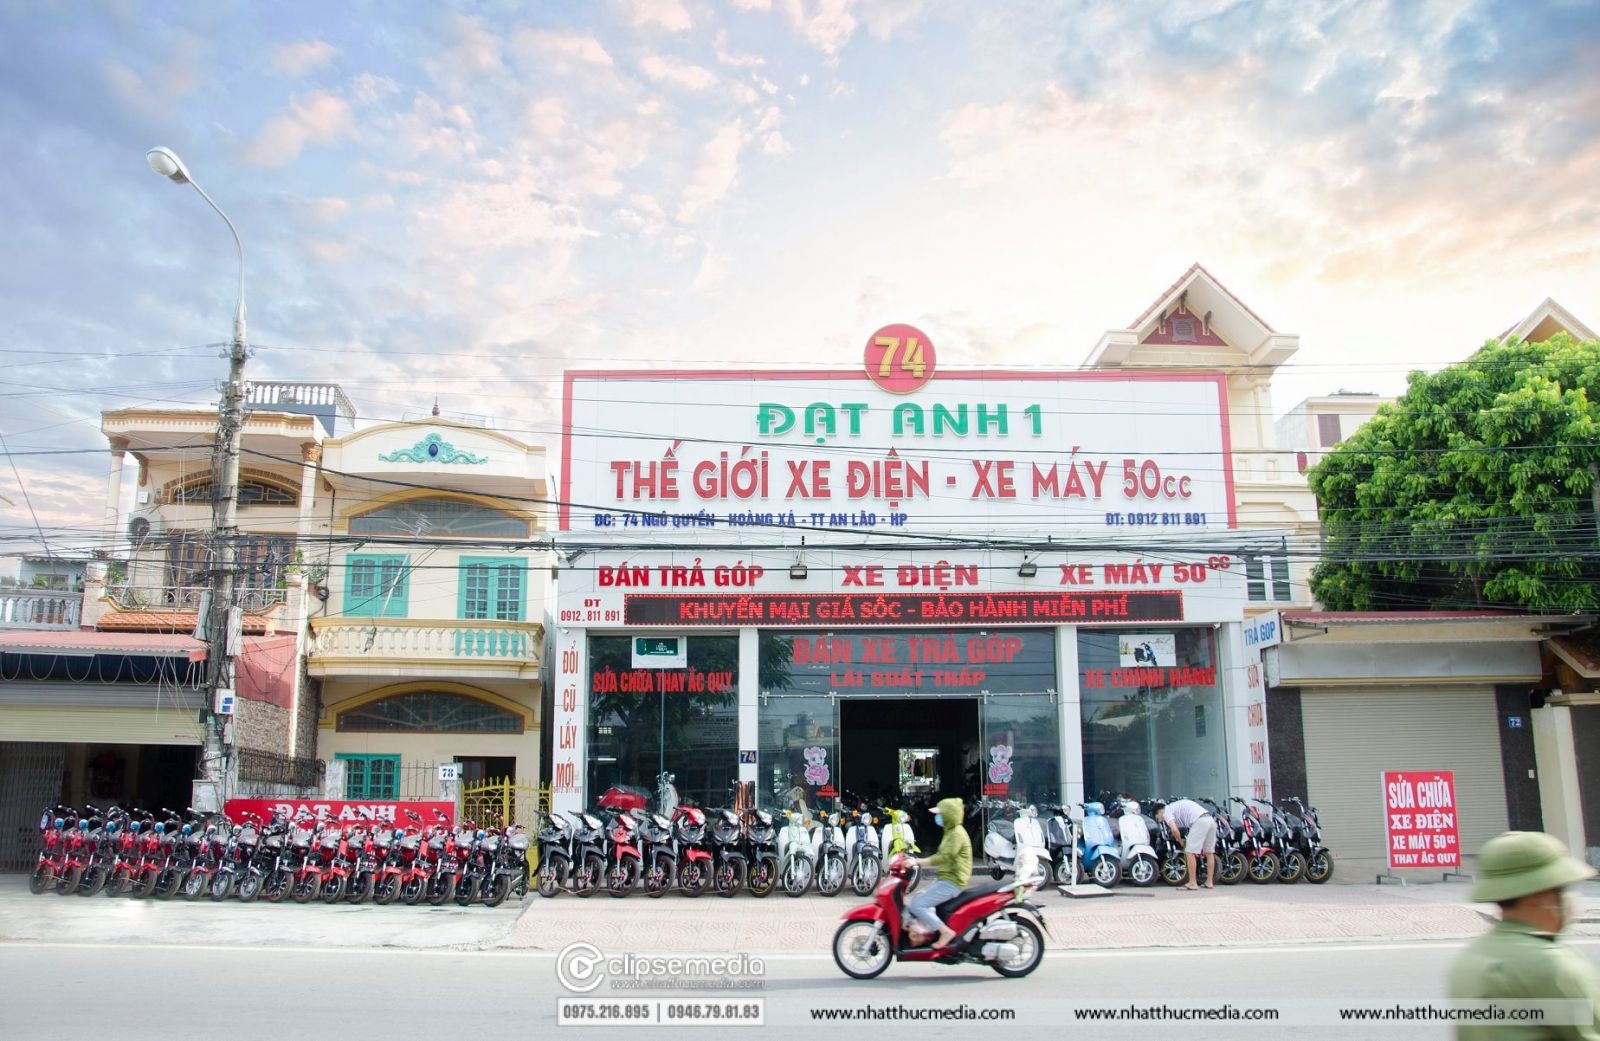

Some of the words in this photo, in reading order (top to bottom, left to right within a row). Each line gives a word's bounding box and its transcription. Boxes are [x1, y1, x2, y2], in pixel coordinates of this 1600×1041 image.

[875, 336, 926, 378] 74
[756, 402, 869, 444] ĐẠT
[892, 402, 1009, 437] ANH
[1024, 403, 1042, 437] 1
[610, 439, 681, 500] THẾ
[785, 460, 831, 499] XE
[846, 446, 930, 507] ĐIỆN
[972, 460, 1016, 499] XE
[1032, 446, 1108, 499] MÁY
[1123, 459, 1192, 499] 50cc
[594, 513, 616, 527] ĐC:
[622, 513, 638, 527] 74
[641, 510, 668, 527] NGÔ
[728, 509, 773, 527] HOÀNG
[810, 513, 825, 526] TT
[829, 513, 848, 526] AN
[890, 513, 908, 526] HP
[1127, 512, 1158, 525] 0912
[1161, 512, 1180, 525] 811
[598, 561, 650, 587] BÁN
[658, 557, 706, 587] TRẢ
[713, 560, 764, 587] GÓP
[840, 564, 885, 586] XE
[896, 560, 979, 591] ĐIỆN
[1059, 563, 1096, 585] XE
[1104, 559, 1164, 585] MÁY
[584, 599, 601, 607] ĐT
[680, 595, 763, 619] KHUYẾN
[769, 601, 810, 623] MẠI
[816, 595, 855, 619] GIÁ
[921, 596, 963, 618] BẢO
[969, 595, 1027, 617] HÀNH
[1092, 595, 1128, 616] PHÍ
[605, 610, 620, 621] 891
[563, 640, 578, 674] ĐỔI
[792, 631, 850, 664] BÁN
[861, 637, 897, 664] XE
[907, 627, 959, 664] TRẢ
[966, 632, 1023, 664] GÓP
[656, 671, 686, 692] THAY
[707, 671, 733, 693] QUY
[1085, 668, 1106, 688] XE
[1110, 665, 1165, 688] CHÍNH
[563, 683, 577, 712] CŨ
[741, 751, 756, 763] 74
[442, 768, 454, 778] 78
[556, 757, 575, 787] MỚI
[1388, 774, 1415, 809] SỬA
[1417, 776, 1453, 808] CHỮA
[338, 804, 397, 821] ANH
[1390, 814, 1413, 829] XE
[1415, 809, 1454, 832] ĐIỆN
[1392, 835, 1406, 849] XE
[1408, 832, 1431, 849] MÁY
[1393, 854, 1419, 864] THAY
[1437, 853, 1457, 864] QUY
